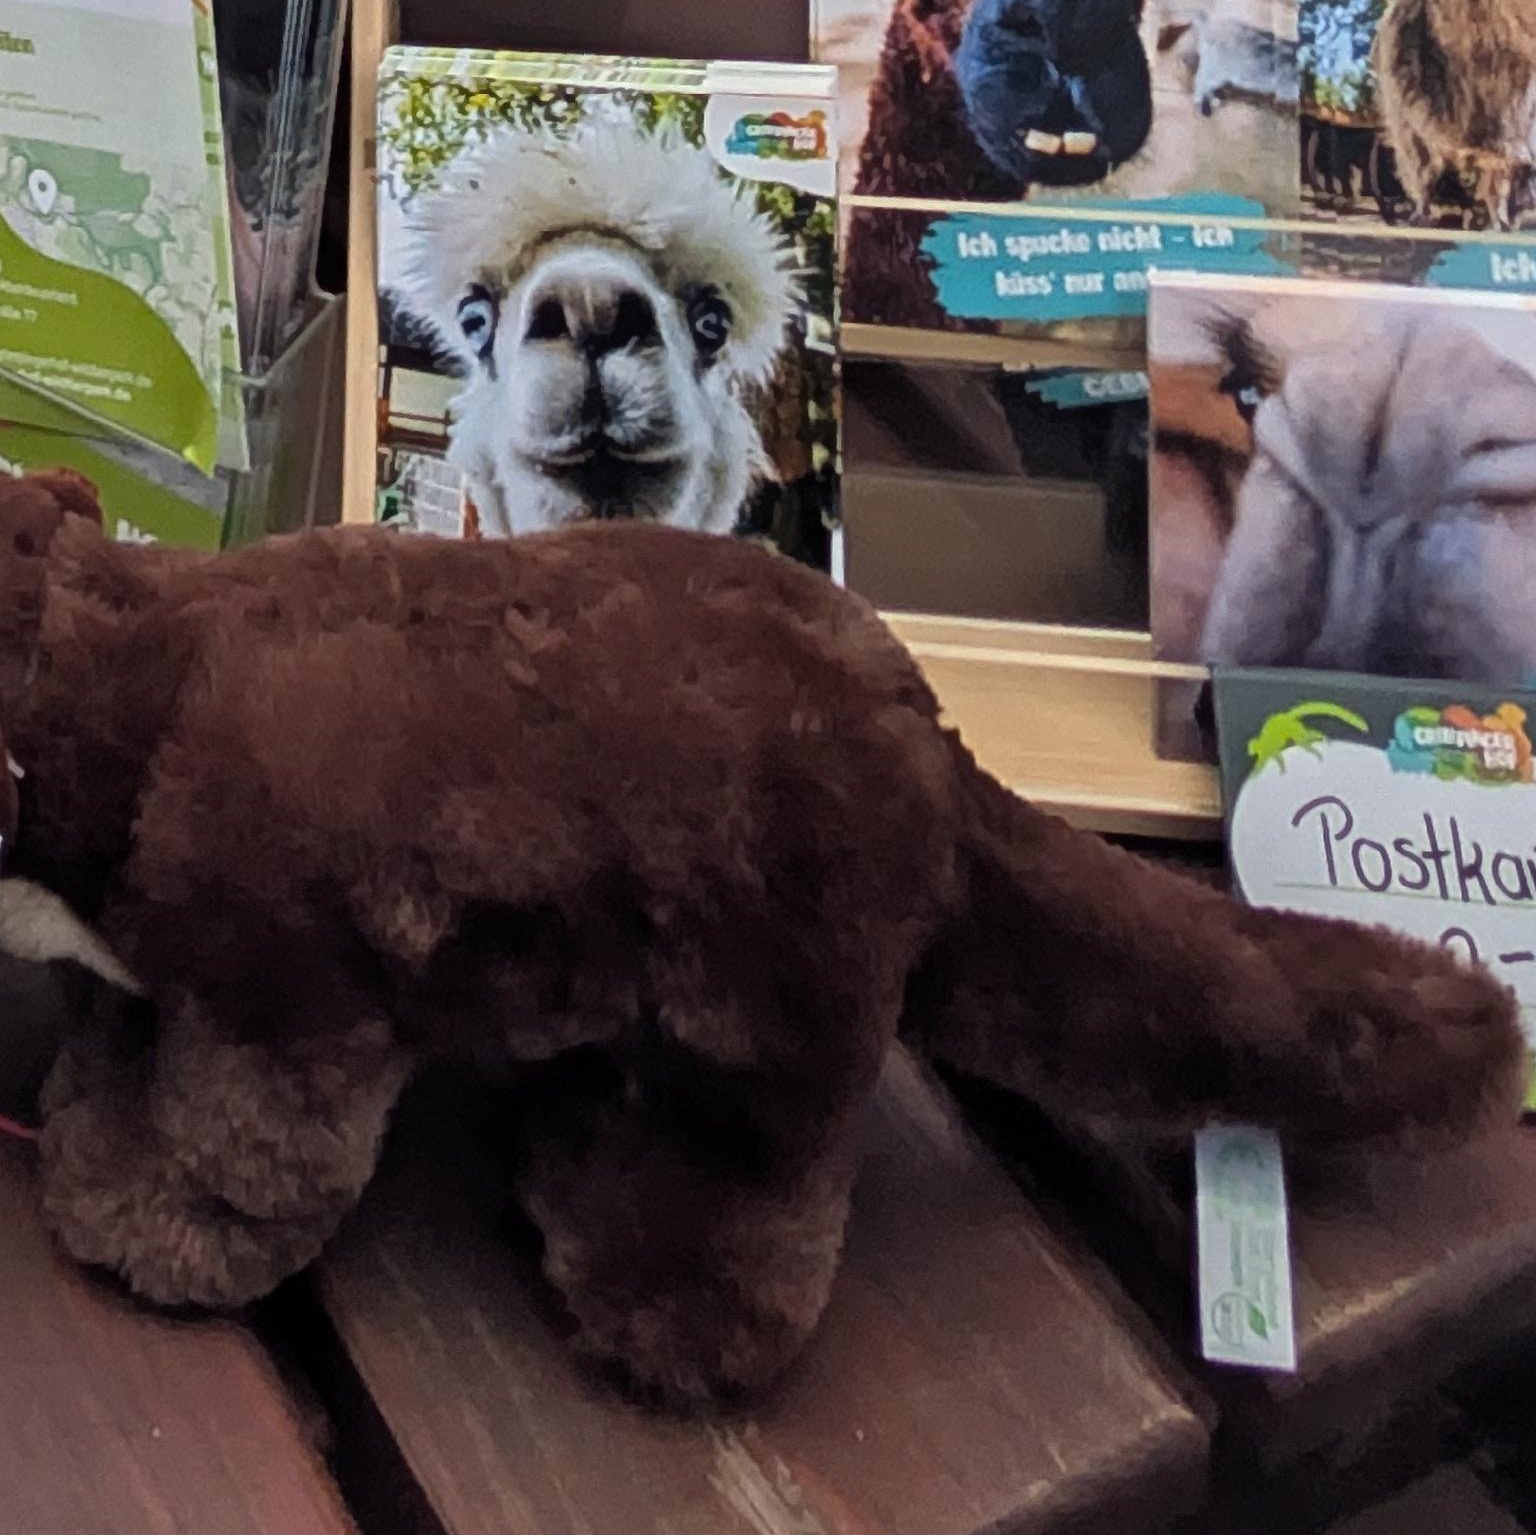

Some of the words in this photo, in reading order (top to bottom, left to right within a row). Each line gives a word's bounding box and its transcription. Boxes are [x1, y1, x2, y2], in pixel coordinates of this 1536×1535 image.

[957, 230, 997, 258] Ich
[1004, 228, 1091, 262] spucke
[1097, 224, 1163, 252] nicht
